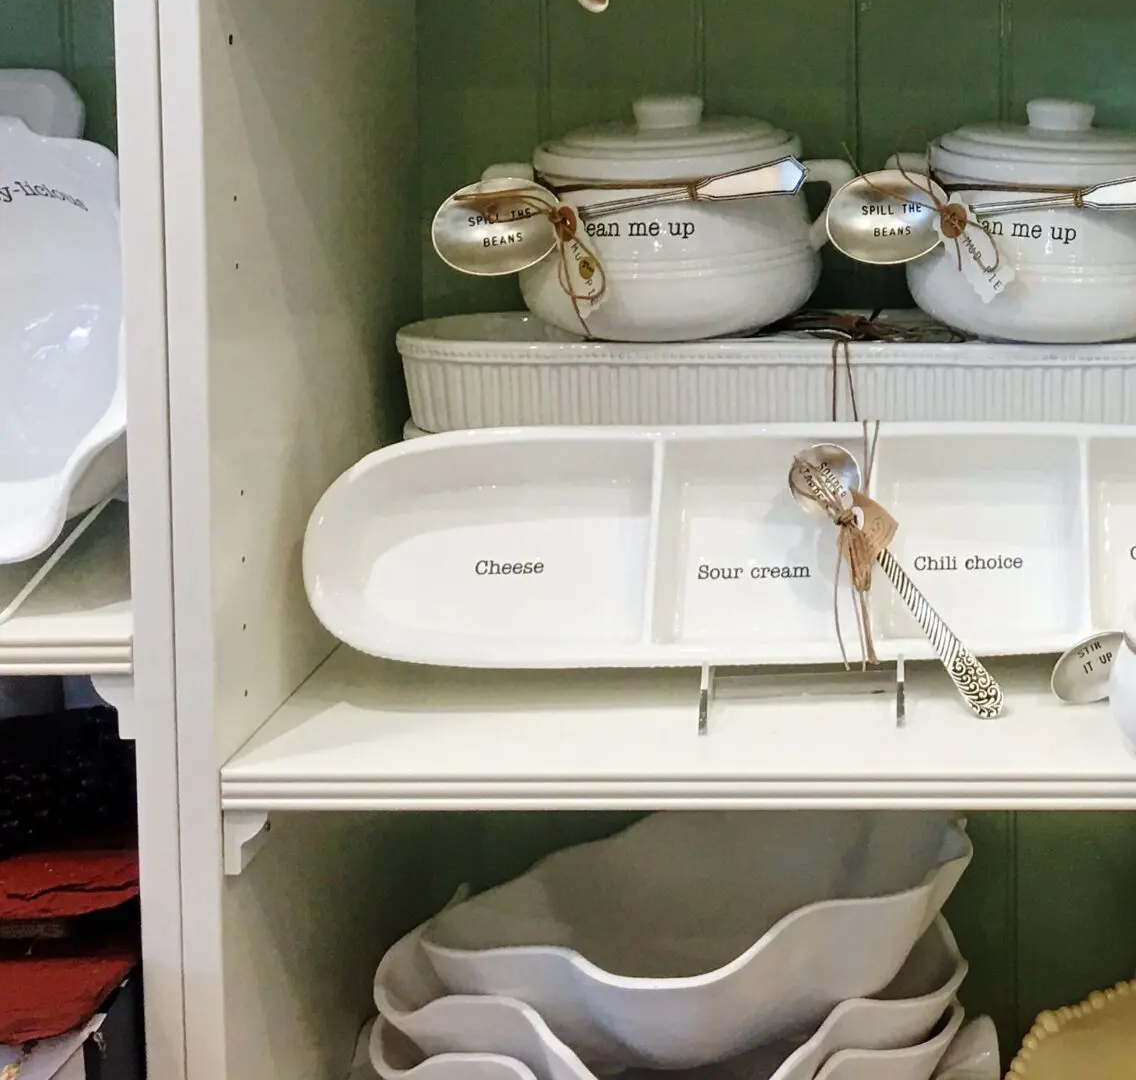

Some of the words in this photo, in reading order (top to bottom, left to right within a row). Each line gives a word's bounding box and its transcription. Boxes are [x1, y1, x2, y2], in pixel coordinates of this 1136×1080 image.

[0, 180, 88, 212] y-licious
[861, 205, 895, 216] SPILL
[902, 203, 923, 213] THE
[586, 222, 621, 237] ean
[627, 222, 660, 237] me
[668, 221, 696, 239] up
[873, 225, 912, 238] BEANS
[1011, 222, 1043, 239] me
[1050, 225, 1077, 244] up
[483, 231, 524, 248] BEANS
[474, 560, 545, 576] Cheese
[913, 555, 957, 571] Chili
[964, 554, 1024, 571] choice
[697, 564, 744, 580] Sour
[750, 565, 812, 579] cream
[1077, 640, 1103, 659] STIR
[1083, 661, 1095, 675] IT
[1099, 651, 1113, 666] UP
